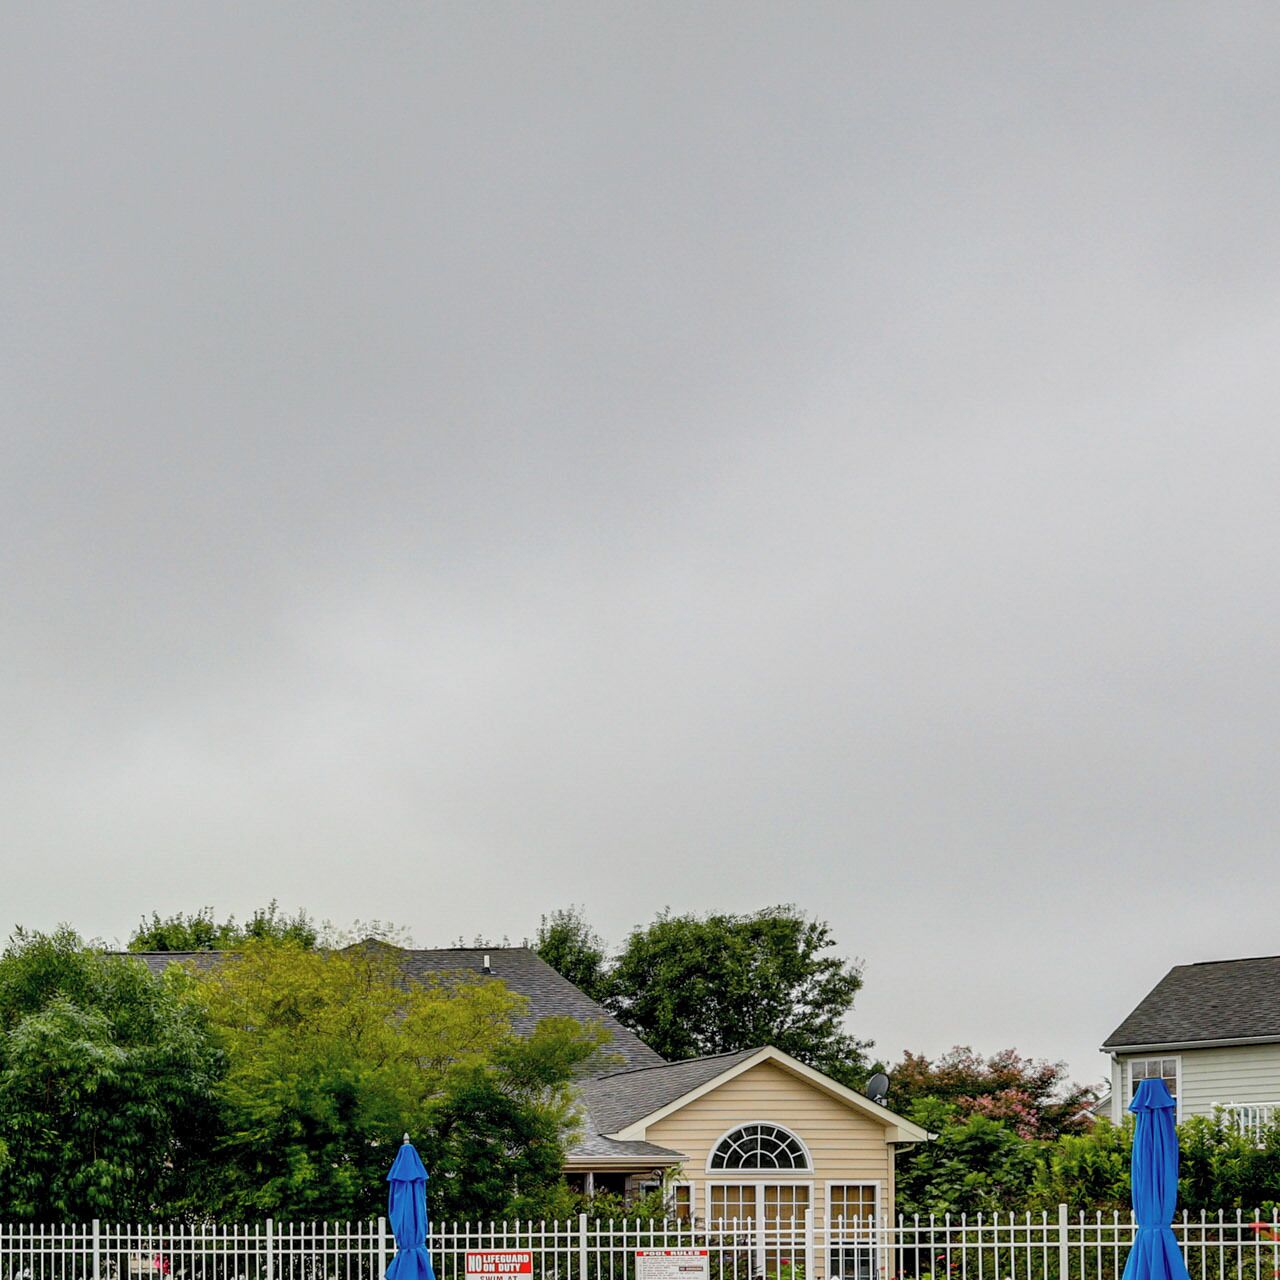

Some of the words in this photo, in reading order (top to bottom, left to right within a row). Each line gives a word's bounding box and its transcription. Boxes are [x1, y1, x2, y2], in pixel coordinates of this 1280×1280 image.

[468, 1255, 482, 1272] NO
[483, 1254, 529, 1263] LIFEGUARD
[483, 1263, 495, 1272] ON
[498, 1263, 520, 1272] DUTY
